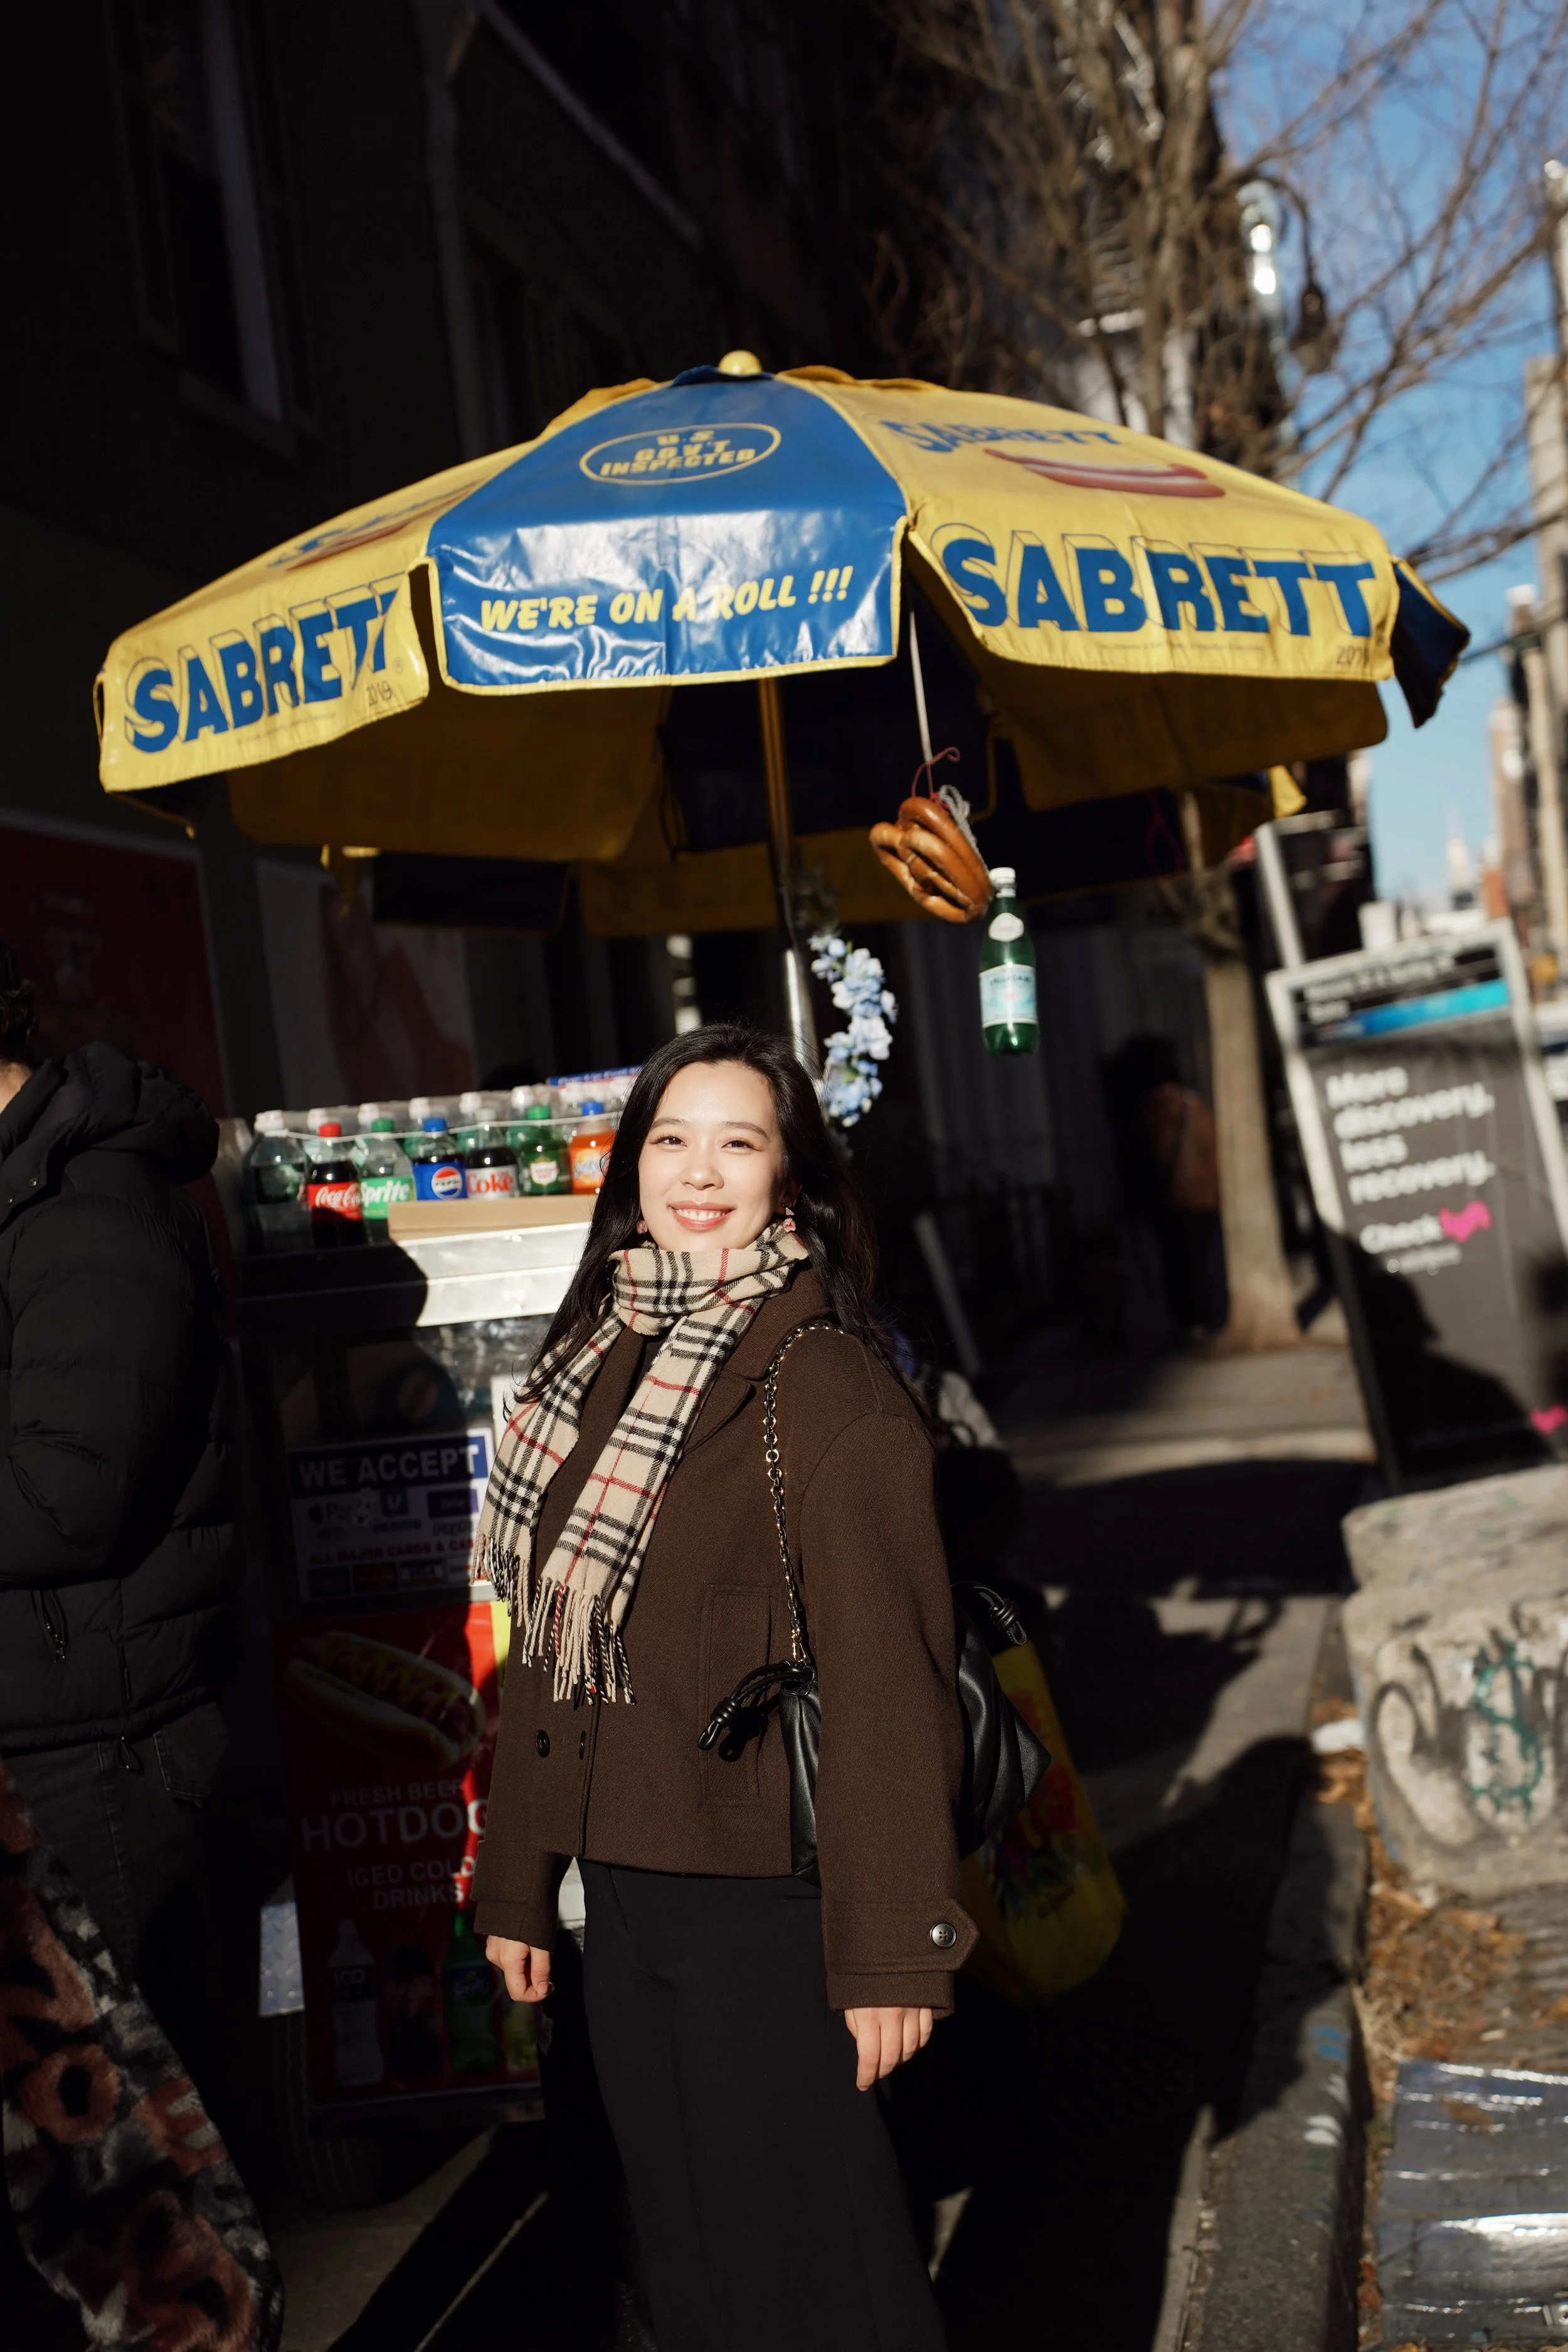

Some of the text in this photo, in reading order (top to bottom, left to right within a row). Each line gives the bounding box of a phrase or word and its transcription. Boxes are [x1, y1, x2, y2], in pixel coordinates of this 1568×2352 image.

[599, 448, 756, 477] INSPECTED
[634, 439, 731, 462] GOV'T
[931, 523, 1375, 637] SABRETT
[481, 566, 854, 631] WE'RE ON A ROLL !!!
[125, 571, 401, 753] SABRETT
[1326, 1066, 1407, 1109] More
[1340, 1134, 1407, 1172] less
[360, 1179, 411, 1208] Sprite
[466, 1171, 514, 1195] Coke
[1360, 1214, 1443, 1254] Check
[297, 1443, 480, 1489] WE ACCEPT
[336, 1547, 383, 1562] MAJOR
[386, 1542, 432, 1556] CARDS
[330, 1778, 463, 1809] FRESH BEEF
[301, 1799, 489, 1853] HOTDOG
[410, 1855, 475, 1880] COLD
[372, 1881, 465, 1910] DRINKS
